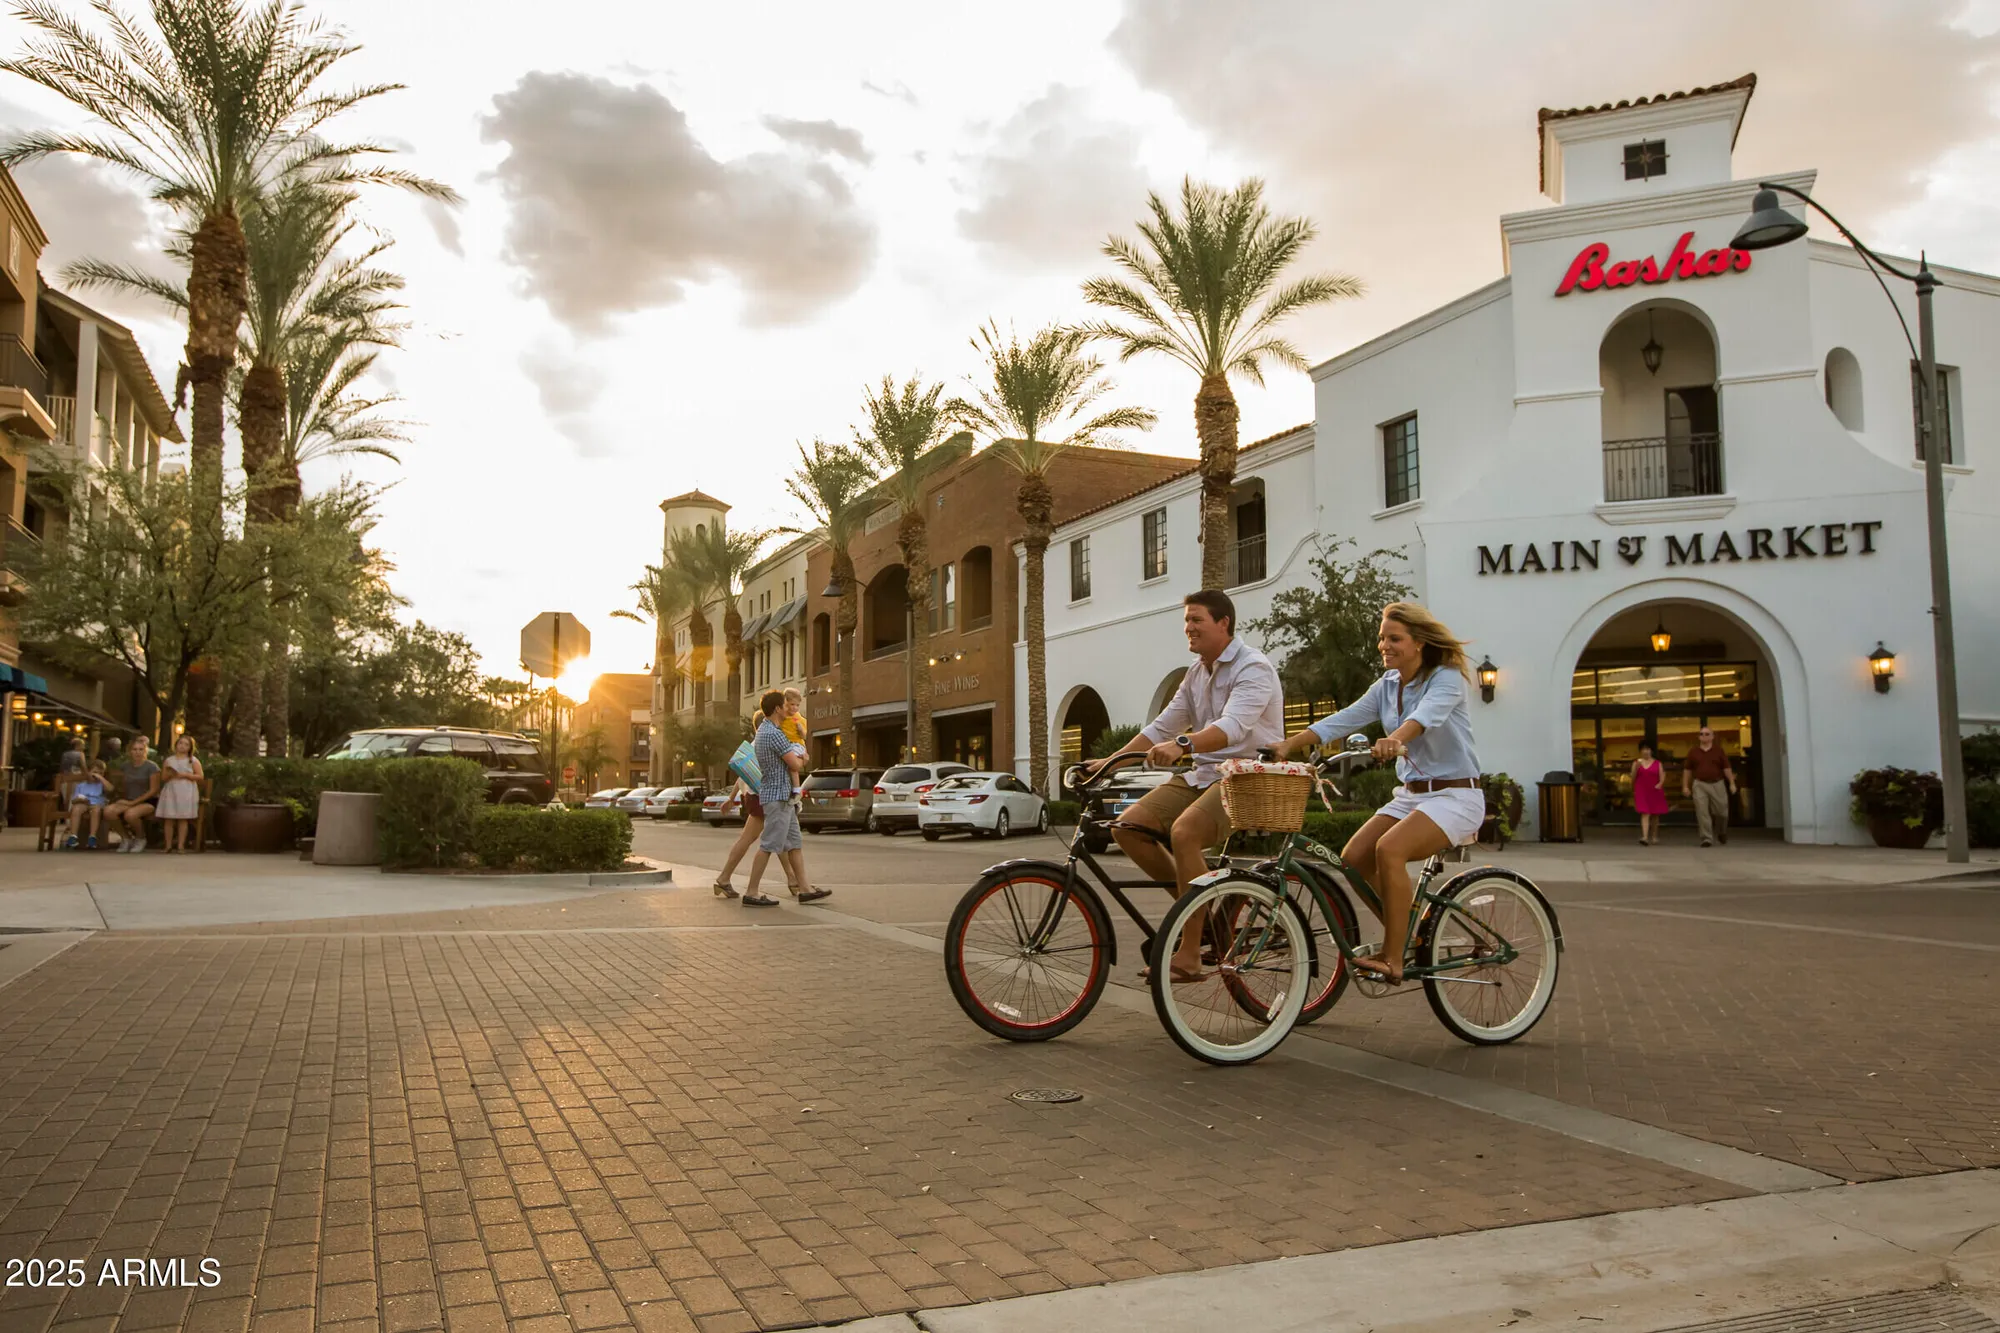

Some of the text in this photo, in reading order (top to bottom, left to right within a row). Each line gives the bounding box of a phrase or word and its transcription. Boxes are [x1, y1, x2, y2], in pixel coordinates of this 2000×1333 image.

[1477, 521, 1882, 575] MAIN ST MARKET
[953, 674, 980, 691] WINES
